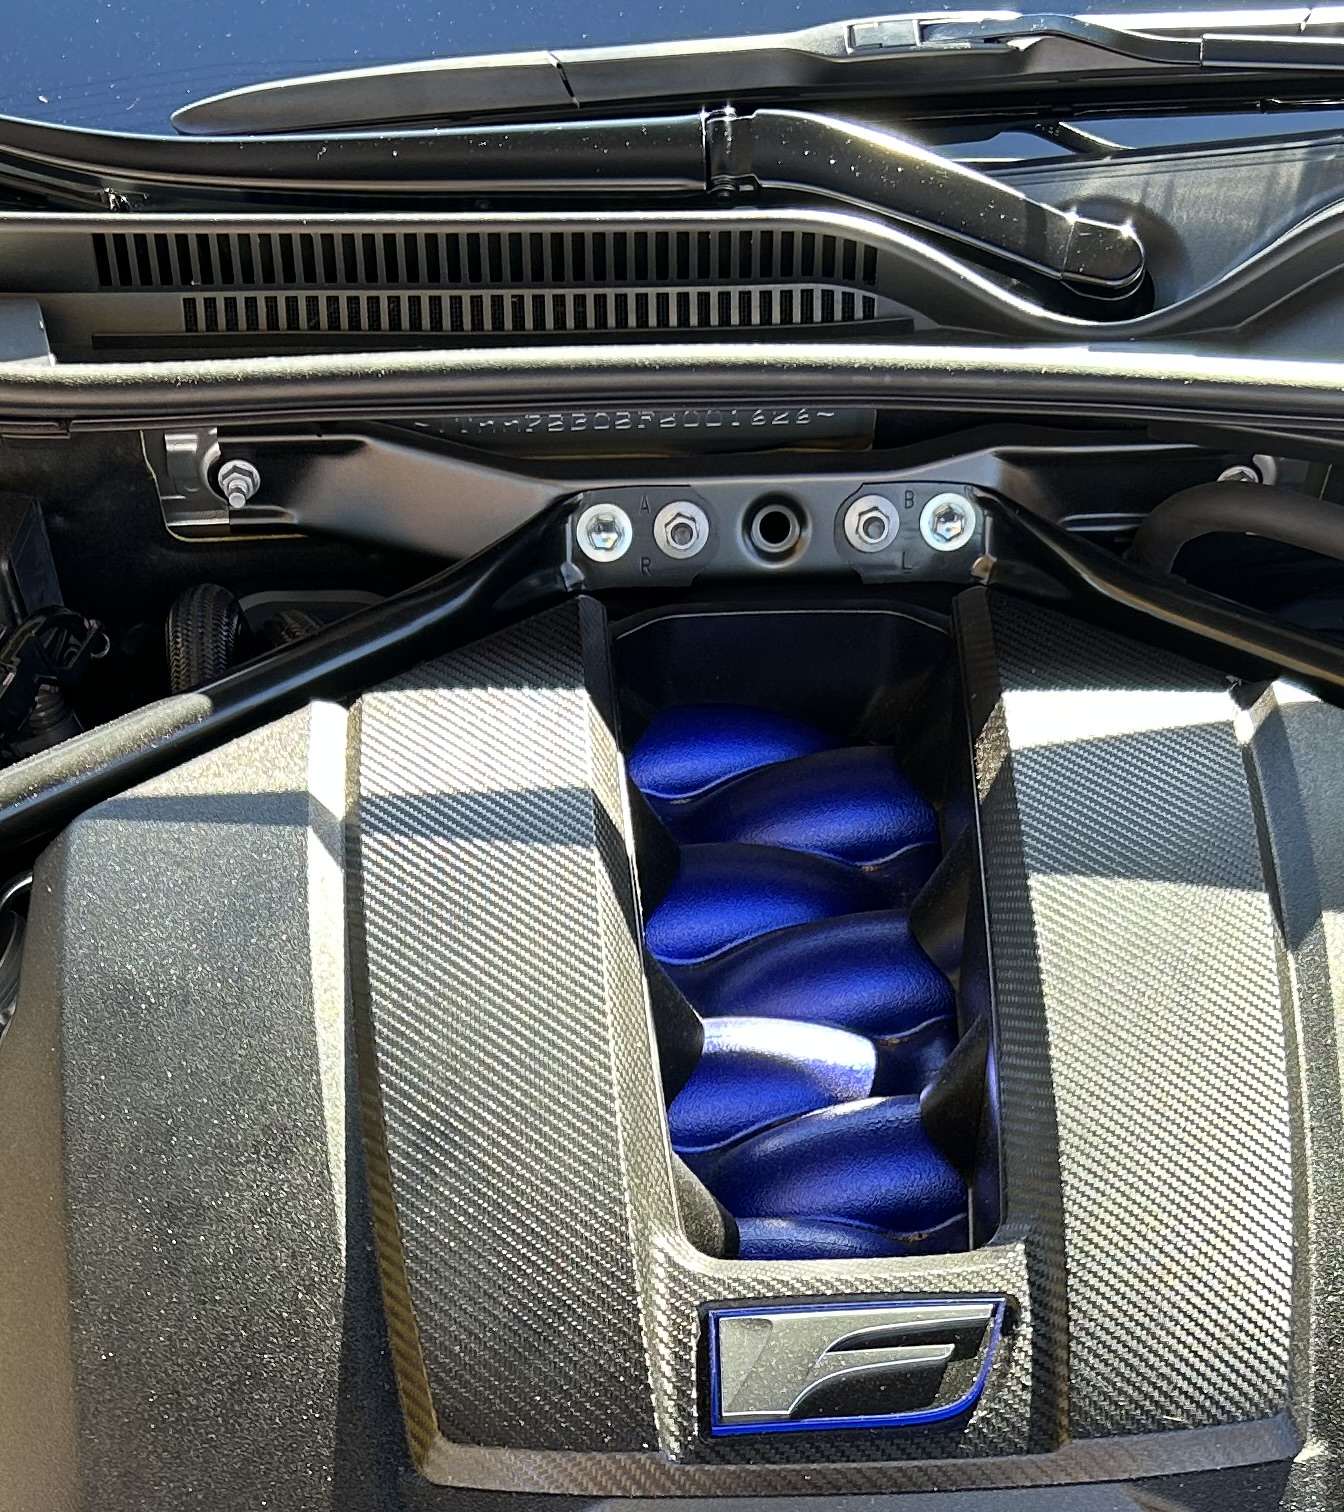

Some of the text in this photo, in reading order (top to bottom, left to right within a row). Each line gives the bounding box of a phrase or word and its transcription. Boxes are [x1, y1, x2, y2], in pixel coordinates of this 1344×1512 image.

[639, 495, 651, 514] A
[904, 490, 916, 509] B
[639, 557, 652, 577] R
[901, 550, 913, 571] L
